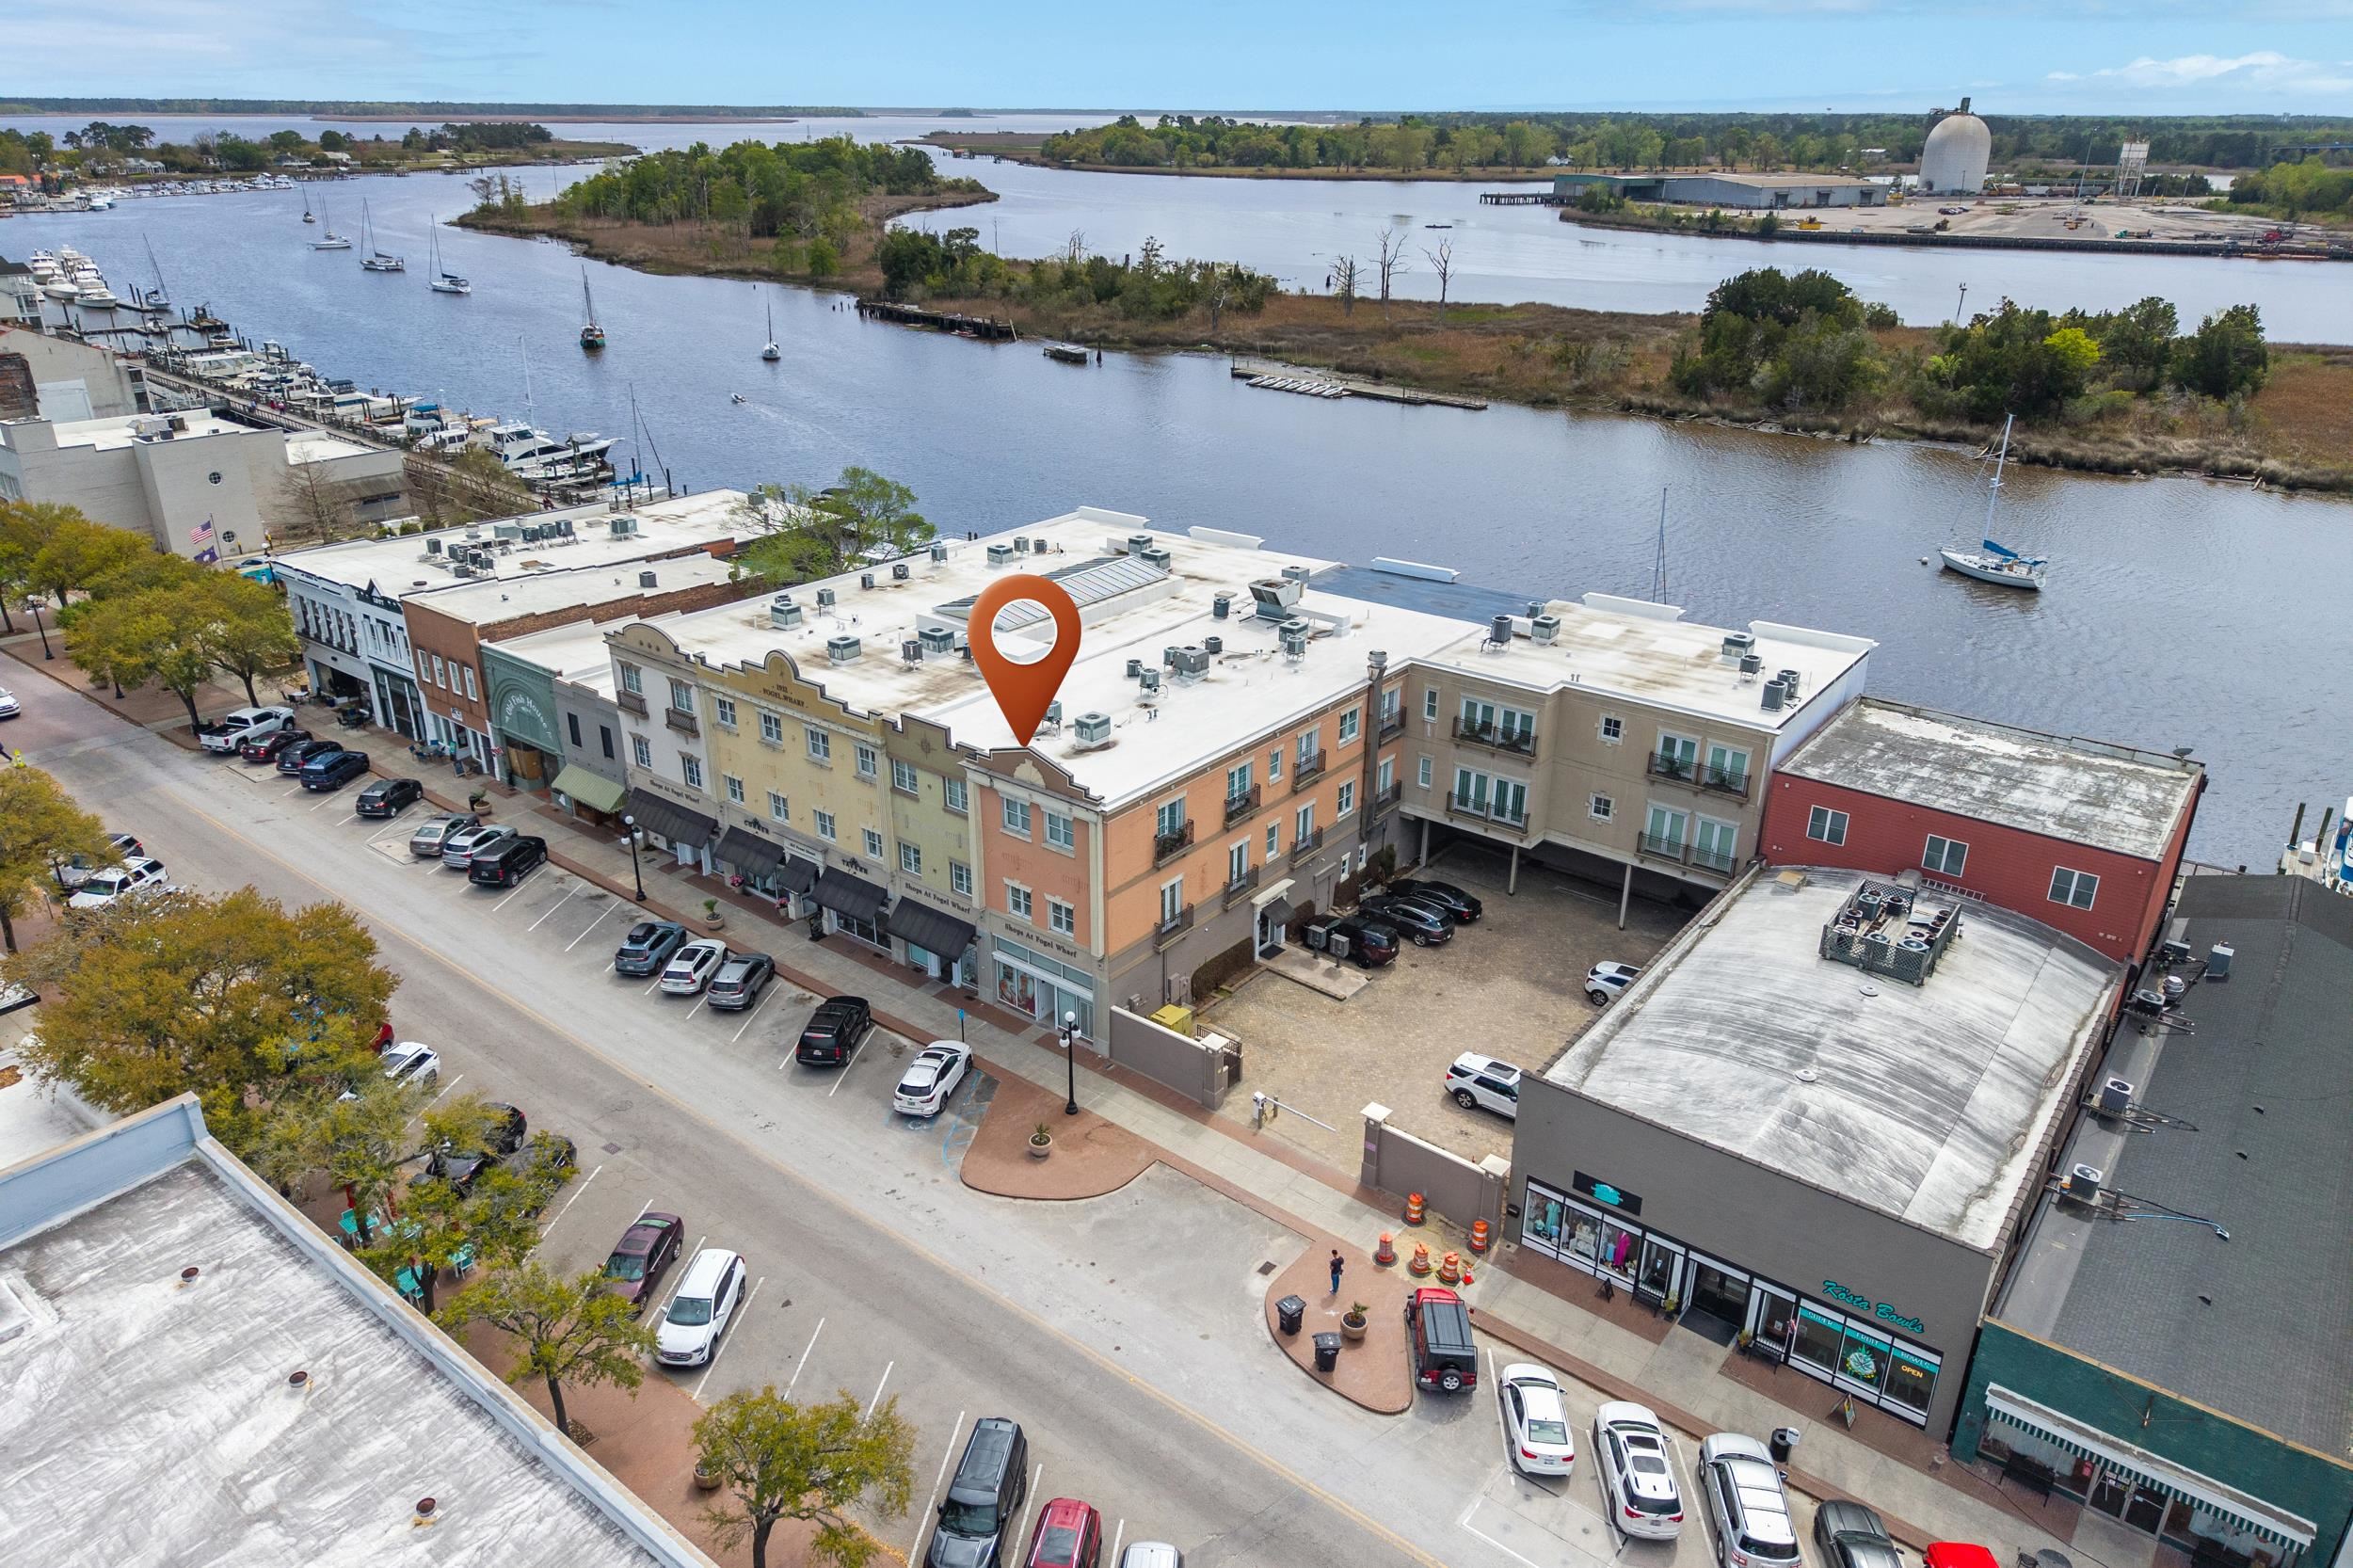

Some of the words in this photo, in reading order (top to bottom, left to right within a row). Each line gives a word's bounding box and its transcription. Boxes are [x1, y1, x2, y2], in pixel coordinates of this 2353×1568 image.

[1004, 922, 1024, 936] Shops
[1035, 936, 1053, 949] Fogel
[1055, 943, 1077, 958] Wharf
[1807, 1310, 1834, 1326] SUPER
[1856, 1331, 1880, 1347] FRUIT
[1875, 1303, 1925, 1334] Bowls
[1900, 1365, 1924, 1379] OPEN
